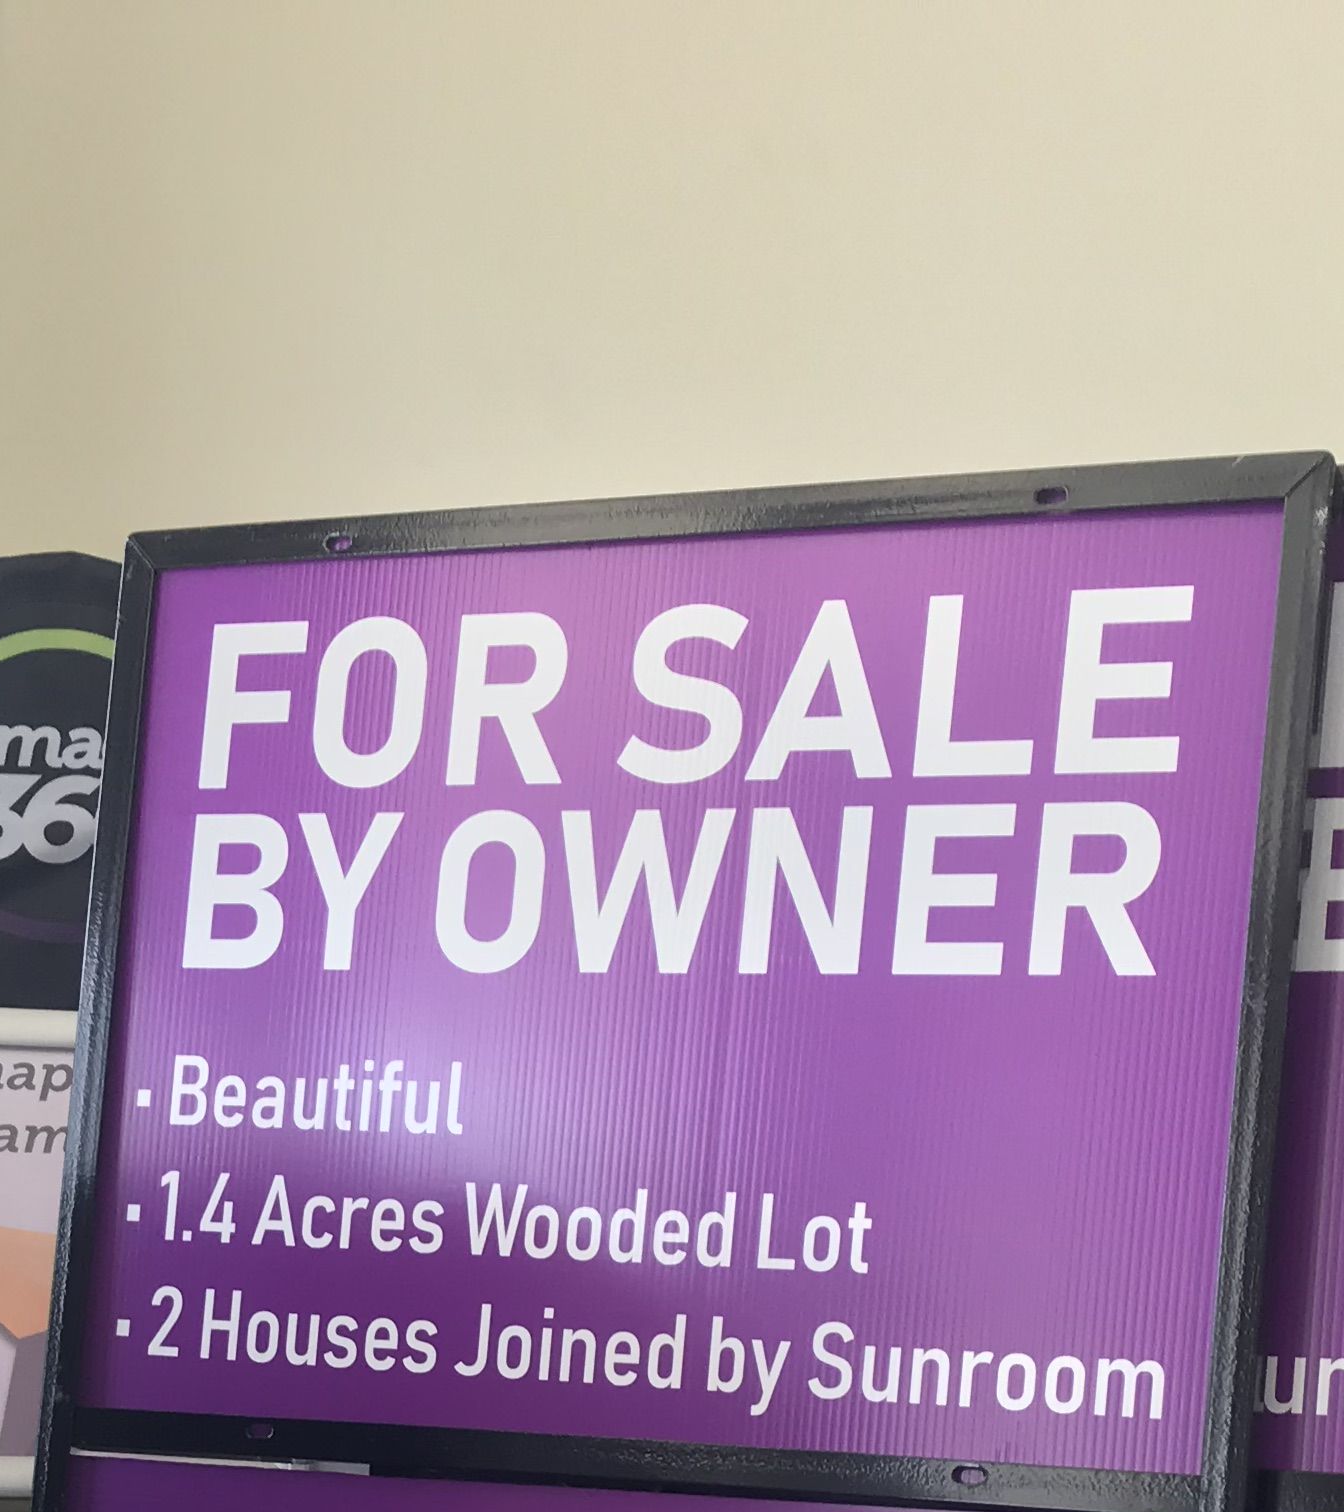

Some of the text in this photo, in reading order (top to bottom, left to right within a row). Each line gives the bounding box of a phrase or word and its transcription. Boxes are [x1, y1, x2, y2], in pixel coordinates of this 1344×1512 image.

[198, 585, 1194, 789] FOR SALE
[182, 802, 1161, 976] BY OWNER
[169, 1054, 462, 1135] Beautiful
[160, 1170, 872, 1273] 1.4 Acres Wooded Lot
[147, 1285, 1165, 1419] 2 Houses Joined by Sunroom
